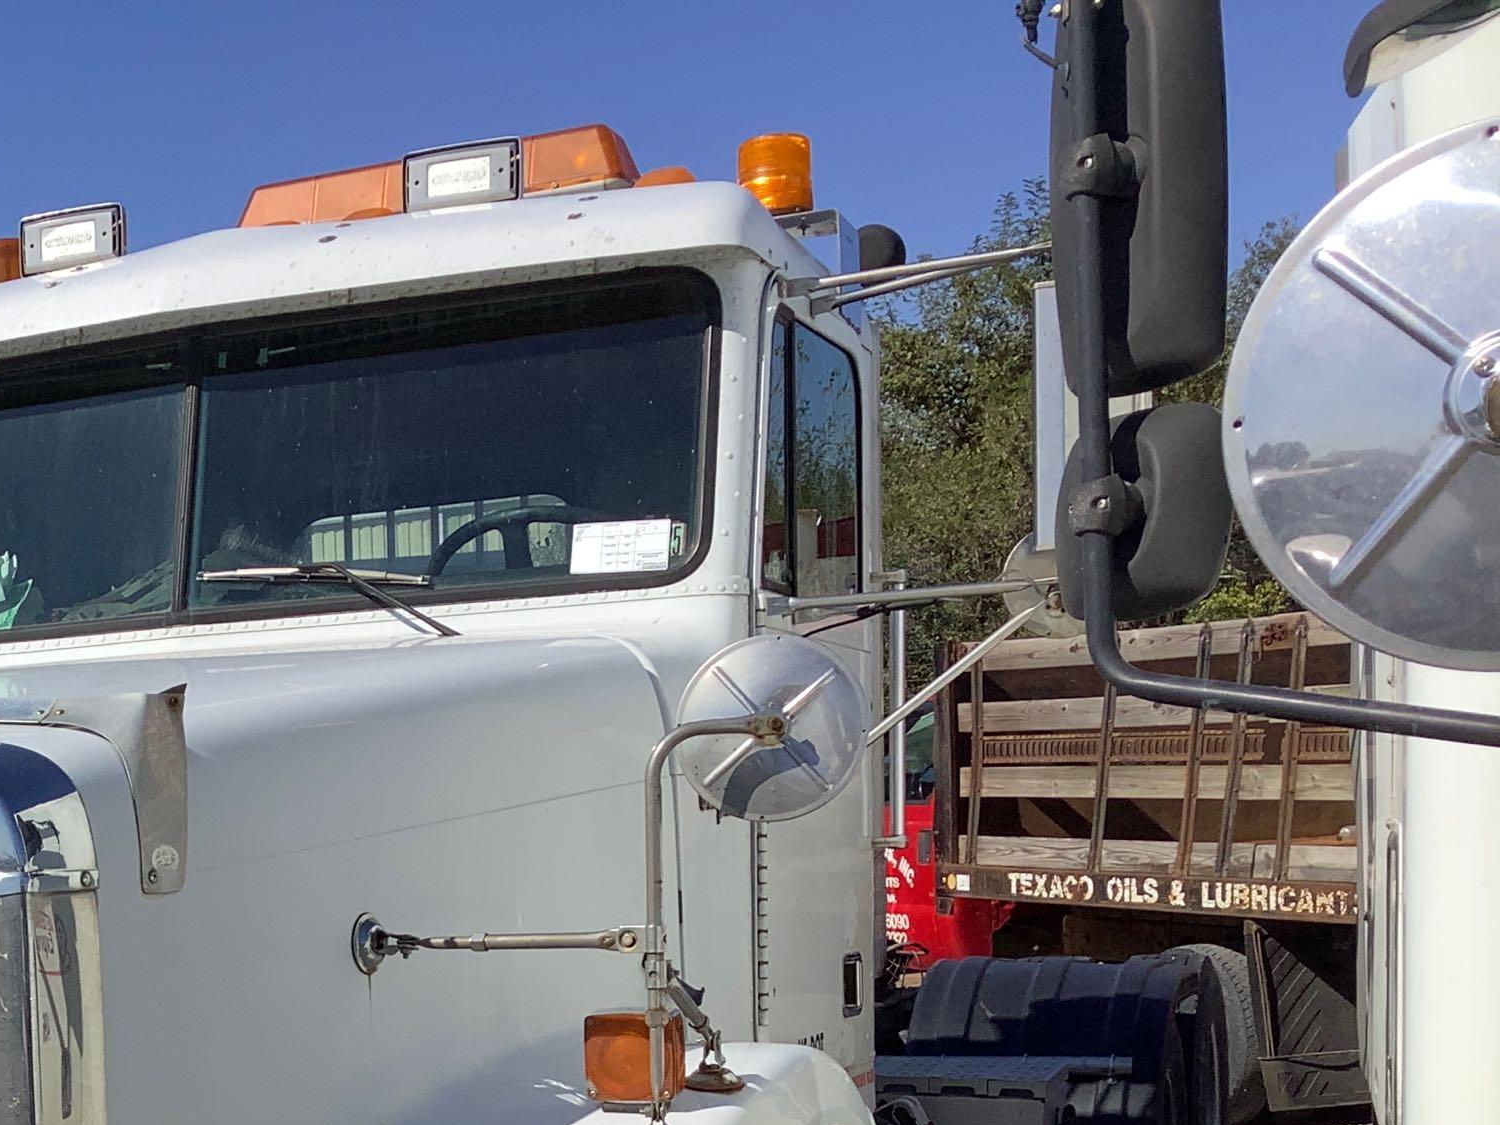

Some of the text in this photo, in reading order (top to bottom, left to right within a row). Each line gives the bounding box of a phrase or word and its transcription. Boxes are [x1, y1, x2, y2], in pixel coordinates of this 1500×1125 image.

[671, 526, 682, 556] 5
[1008, 872, 1094, 900] TEXACO
[1106, 877, 1159, 903] OILS
[1168, 880, 1186, 906] &
